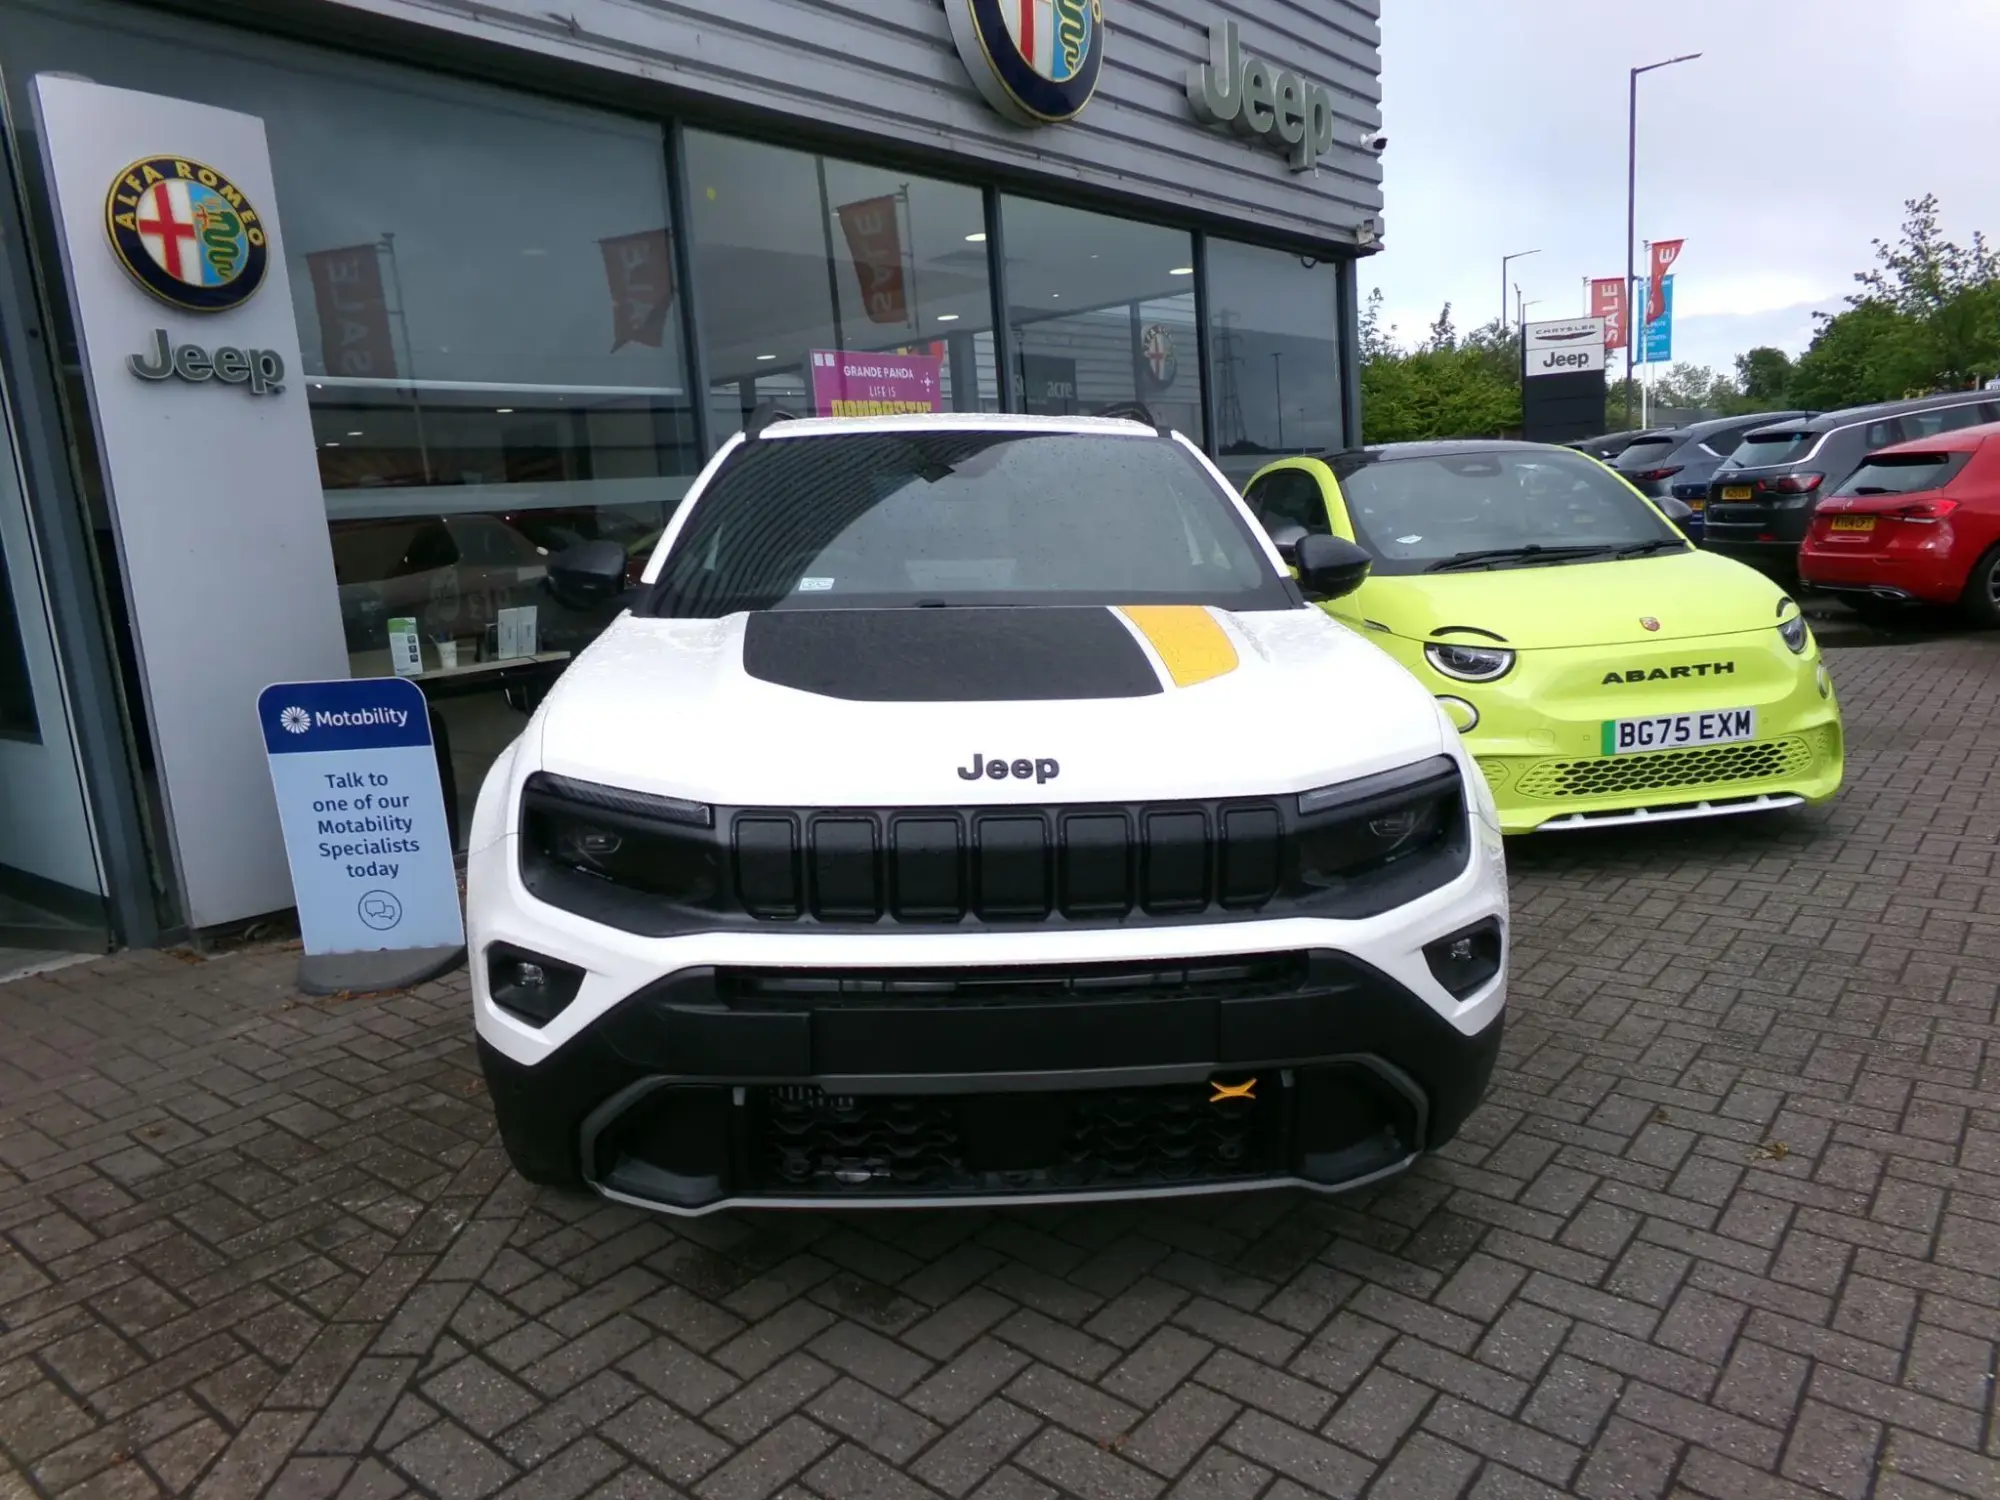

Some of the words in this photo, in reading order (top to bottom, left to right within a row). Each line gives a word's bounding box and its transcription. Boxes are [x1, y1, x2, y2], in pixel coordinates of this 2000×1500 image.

[1190, 19, 1333, 171] Jeep
[116, 164, 164, 231] ALFA
[175, 160, 265, 247] ROMEO
[1601, 283, 1619, 343] SALE
[1535, 324, 1596, 335] CHRYSLER
[127, 328, 285, 394] Jeep
[1542, 351, 1590, 368] Jeep
[843, 365, 882, 378] GRANDE
[884, 367, 915, 380] PANDA
[869, 385, 886, 398] LIFE
[887, 386, 897, 398] IS
[1601, 661, 1734, 685] ABARTH
[315, 707, 408, 727] Motability
[1619, 716, 1691, 747] BG75
[1699, 710, 1751, 740] EXM
[957, 753, 1060, 784] Jeep
[324, 772, 364, 789] Talk
[368, 772, 389, 787] to
[313, 799, 348, 812] one
[353, 794, 374, 810] of
[378, 795, 410, 809] our
[318, 815, 413, 835] Motability
[319, 838, 420, 860] Specialists
[346, 861, 399, 879] today
